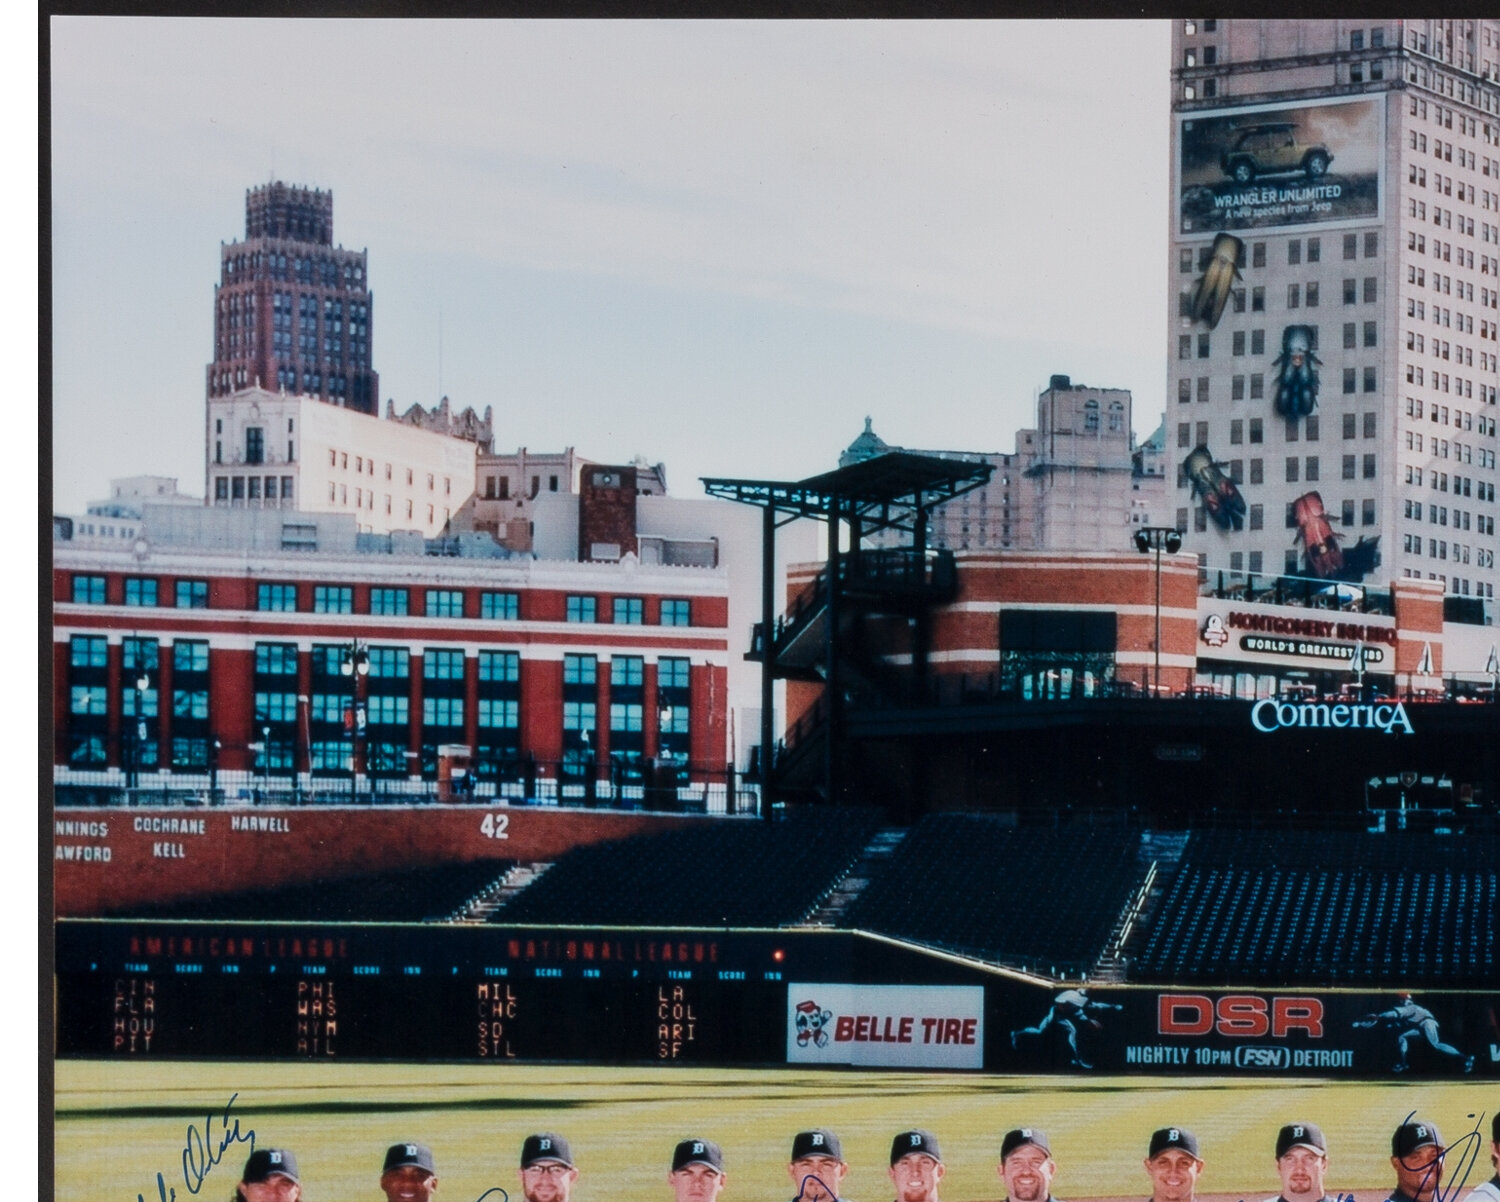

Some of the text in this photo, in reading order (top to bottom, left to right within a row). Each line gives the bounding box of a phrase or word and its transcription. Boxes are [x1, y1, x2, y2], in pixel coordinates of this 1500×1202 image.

[1214, 185, 1341, 208] WRANGLER UNLIMITED
[1225, 209, 1233, 219] A
[1253, 205, 1285, 218] species
[1287, 203, 1310, 214] from
[1311, 201, 1332, 214] Jeep
[1228, 611, 1335, 638] MONTGOMERY
[1336, 622, 1365, 641] INN
[1247, 638, 1295, 653] WORLD'S
[1299, 643, 1353, 659] GREATEST
[134, 817, 205, 835] COCHRANE
[231, 816, 290, 832] HARWELL
[480, 813, 510, 841] 42
[153, 843, 185, 858] KELL
[125, 964, 149, 972] TEAM
[303, 966, 327, 974] TEAM
[484, 967, 508, 976] TEAM
[668, 970, 692, 980] TEAM
[298, 982, 334, 998] PHI
[478, 983, 516, 1000] MIL
[659, 985, 683, 1001] LA
[114, 997, 154, 1014] FLA
[298, 1000, 336, 1016] WAS
[659, 1003, 696, 1019] COL
[1158, 994, 1324, 1038] DSR
[114, 1017, 154, 1034] HOU
[478, 1021, 502, 1038] SD
[659, 1023, 694, 1040] ARI
[834, 1016, 977, 1045] BELLE TIRE
[114, 1035, 152, 1052] PIT
[478, 1040, 516, 1056] STL
[659, 1042, 682, 1058] SF
[1126, 1046, 1190, 1064] NIGHTLY
[1243, 1048, 1282, 1066] FSN
[1293, 1050, 1354, 1067] DETROIT
